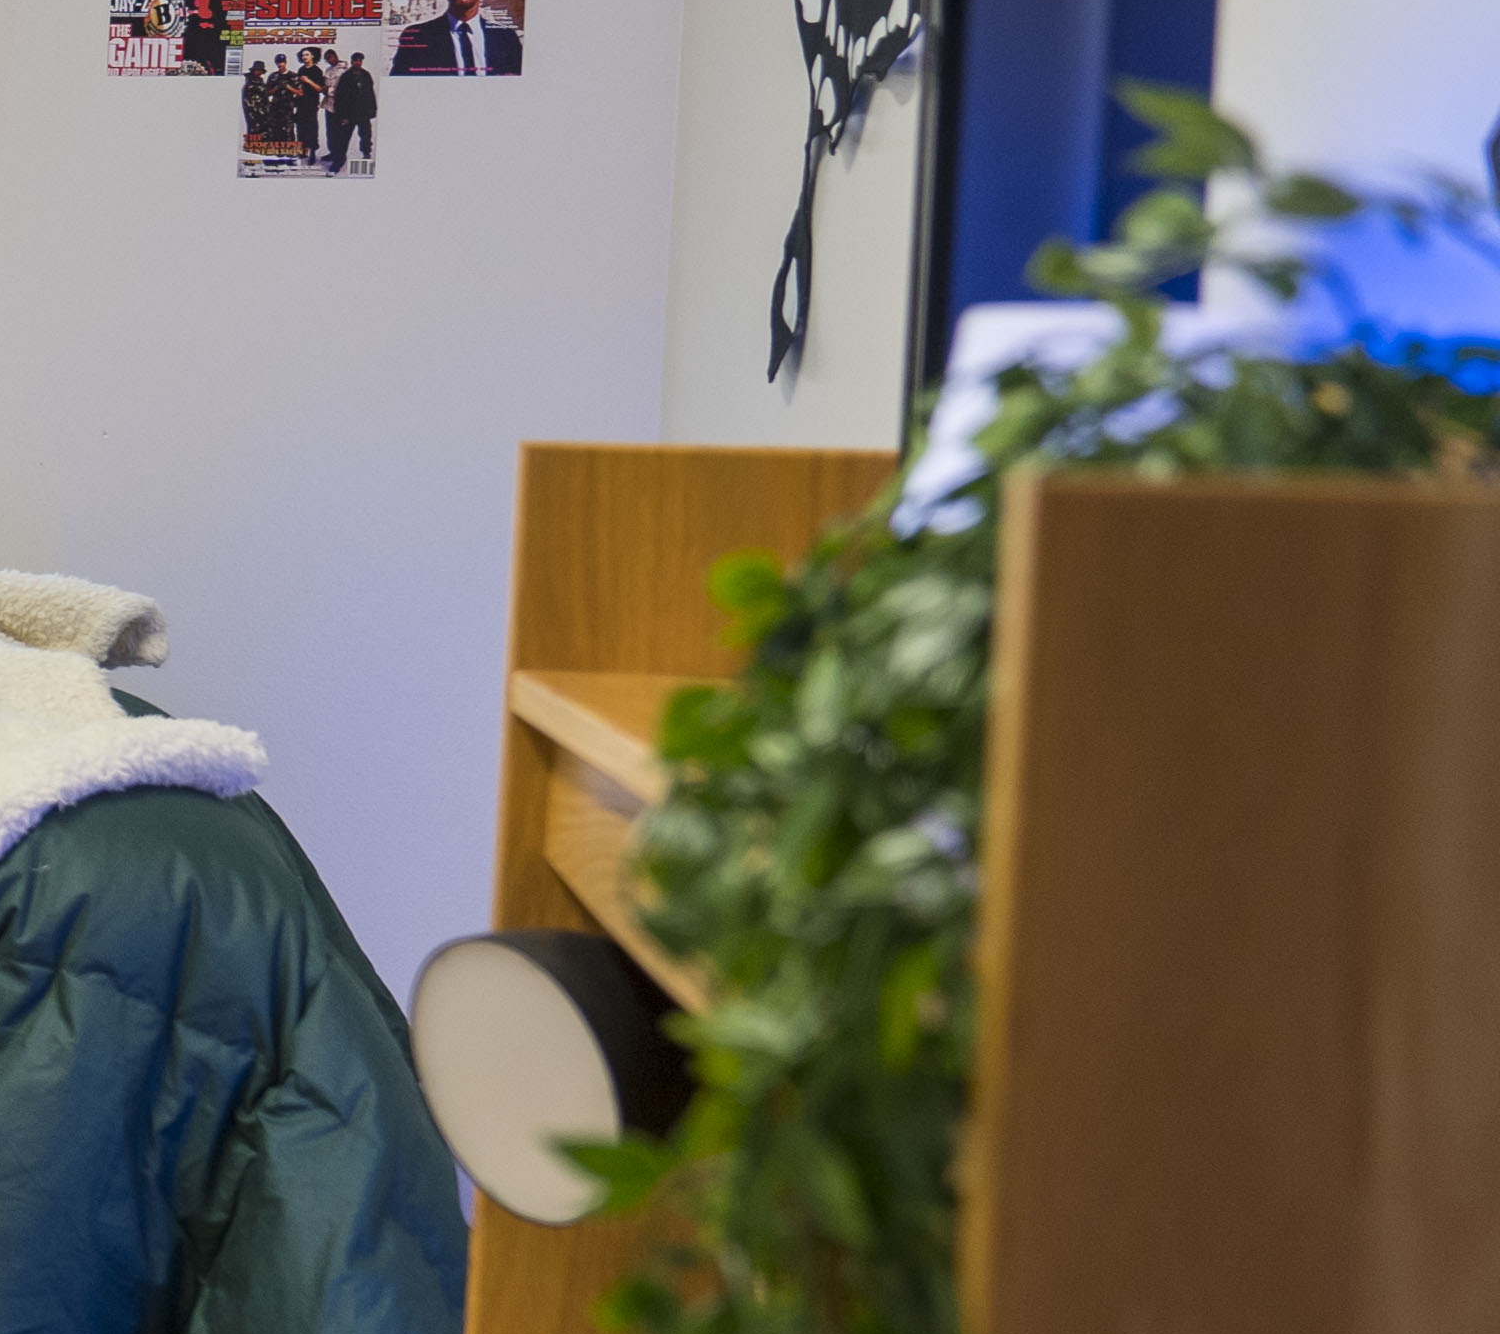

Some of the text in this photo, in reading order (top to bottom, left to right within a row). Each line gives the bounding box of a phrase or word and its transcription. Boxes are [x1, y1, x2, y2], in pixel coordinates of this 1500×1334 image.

[156, 4, 172, 28] B
[109, 24, 132, 37] THE
[108, 38, 184, 68] GAME
